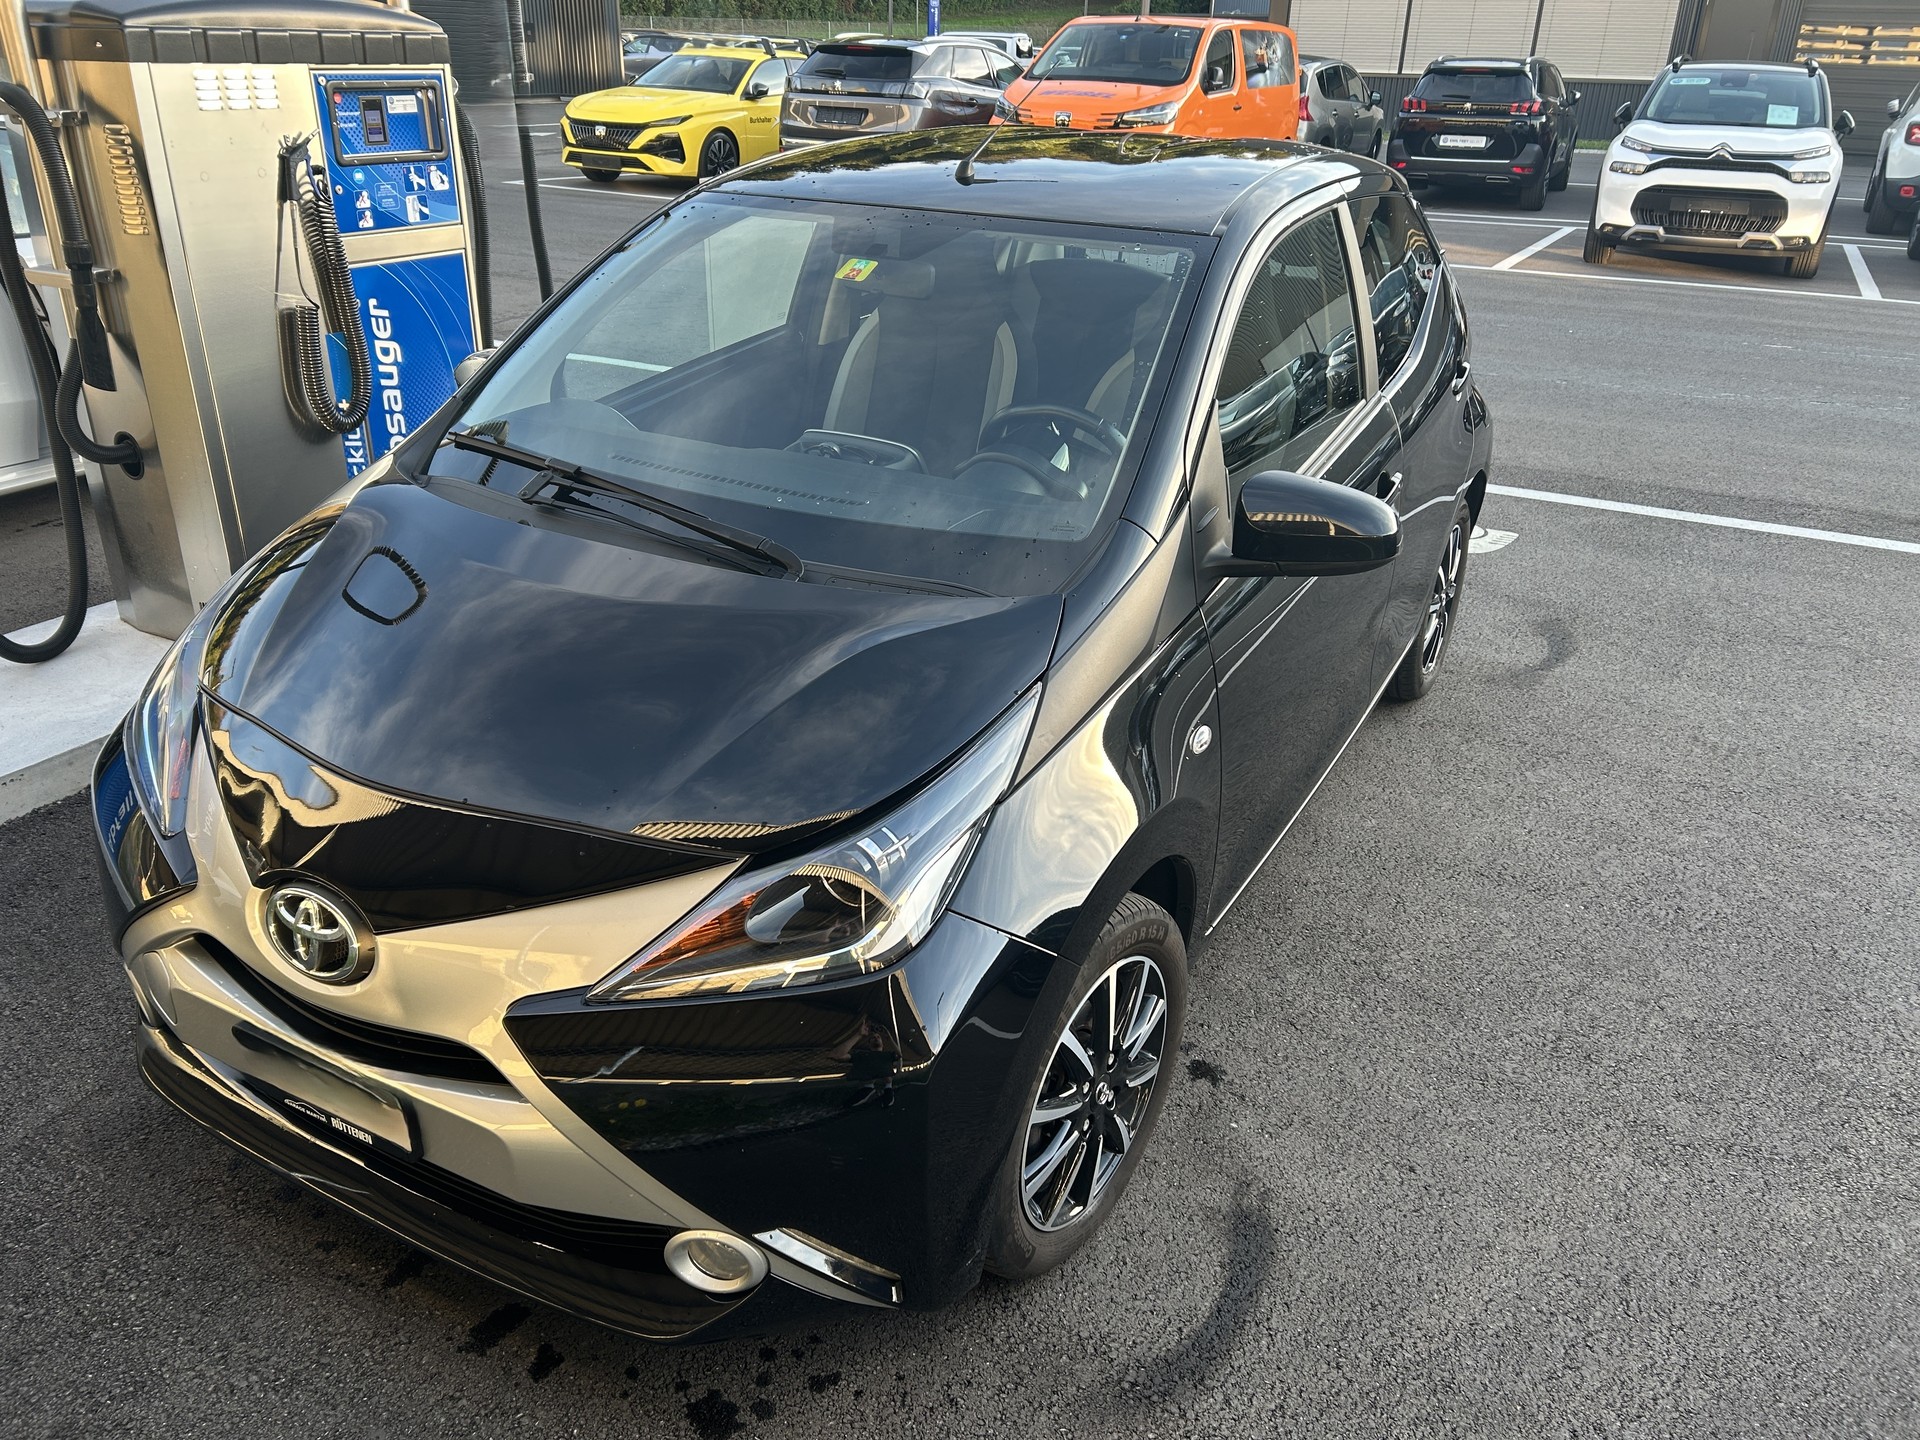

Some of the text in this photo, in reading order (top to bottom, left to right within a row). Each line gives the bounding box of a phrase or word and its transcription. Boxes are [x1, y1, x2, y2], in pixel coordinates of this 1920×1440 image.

[1139, 926, 1147, 940] R
[1147, 925, 1157, 939] 15
[330, 1117, 373, 1145] RÜTTENEN
